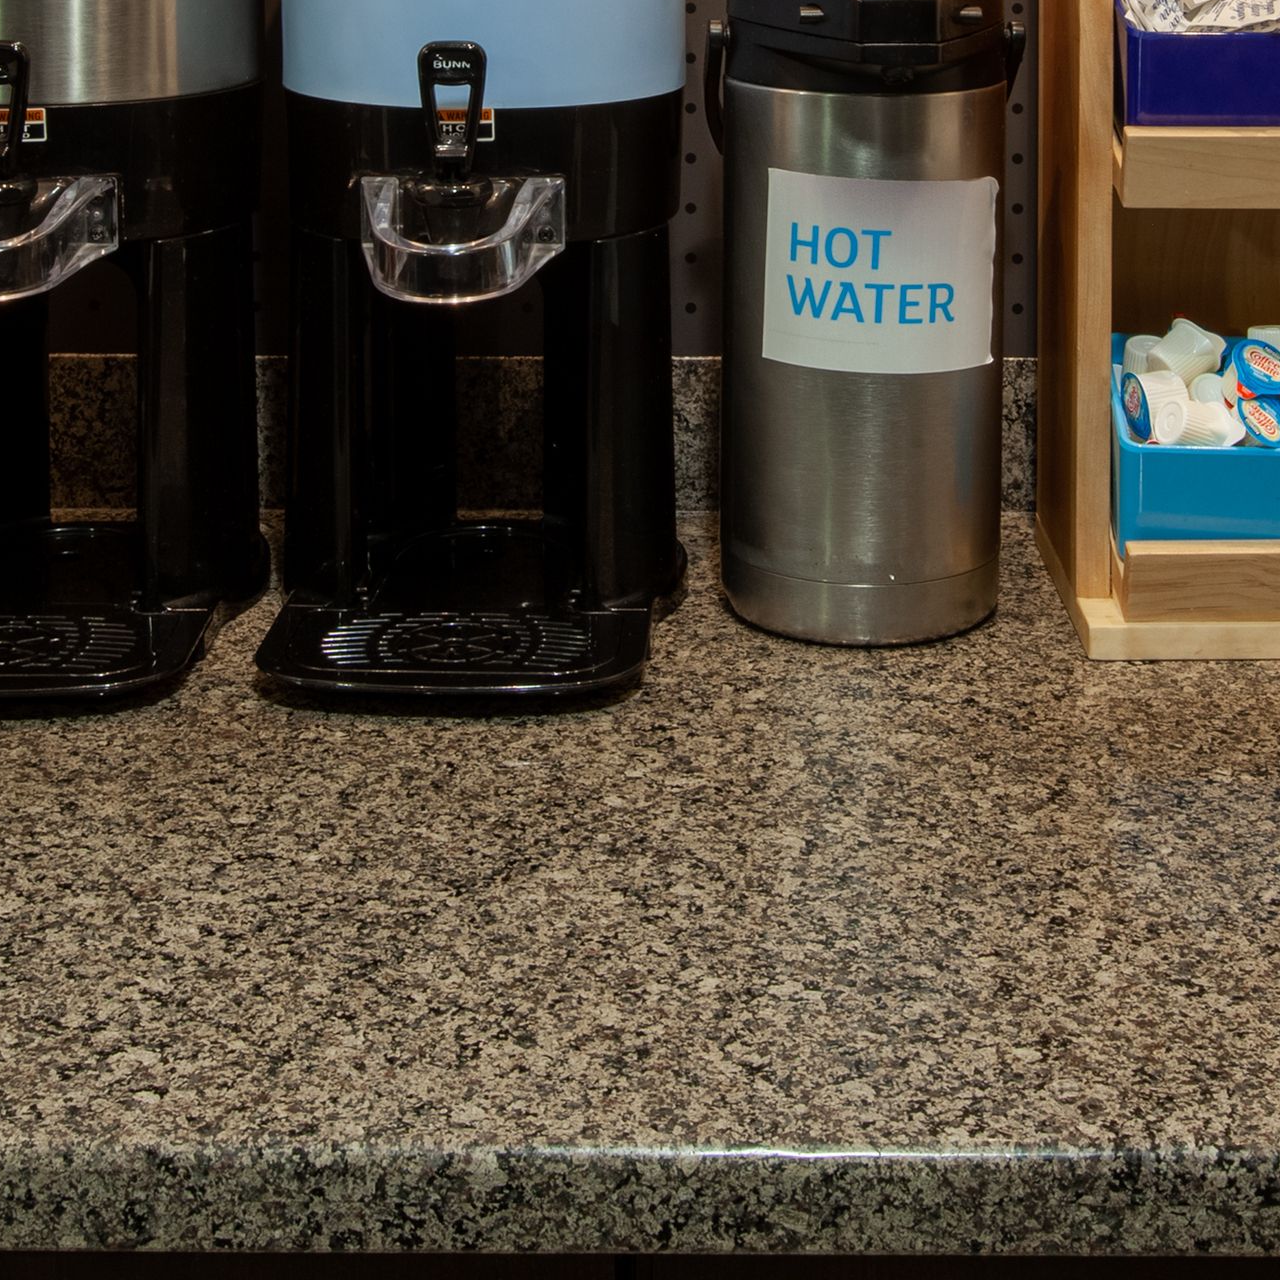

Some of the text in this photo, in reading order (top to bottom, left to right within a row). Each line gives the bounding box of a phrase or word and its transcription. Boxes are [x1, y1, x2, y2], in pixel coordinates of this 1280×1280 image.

[433, 60, 471, 69] BUNN
[789, 221, 893, 270] HOT
[786, 273, 955, 324] WATER
[1249, 350, 1280, 370] Coffee
[1253, 360, 1280, 377] mate
[1248, 408, 1276, 435] Coffee
